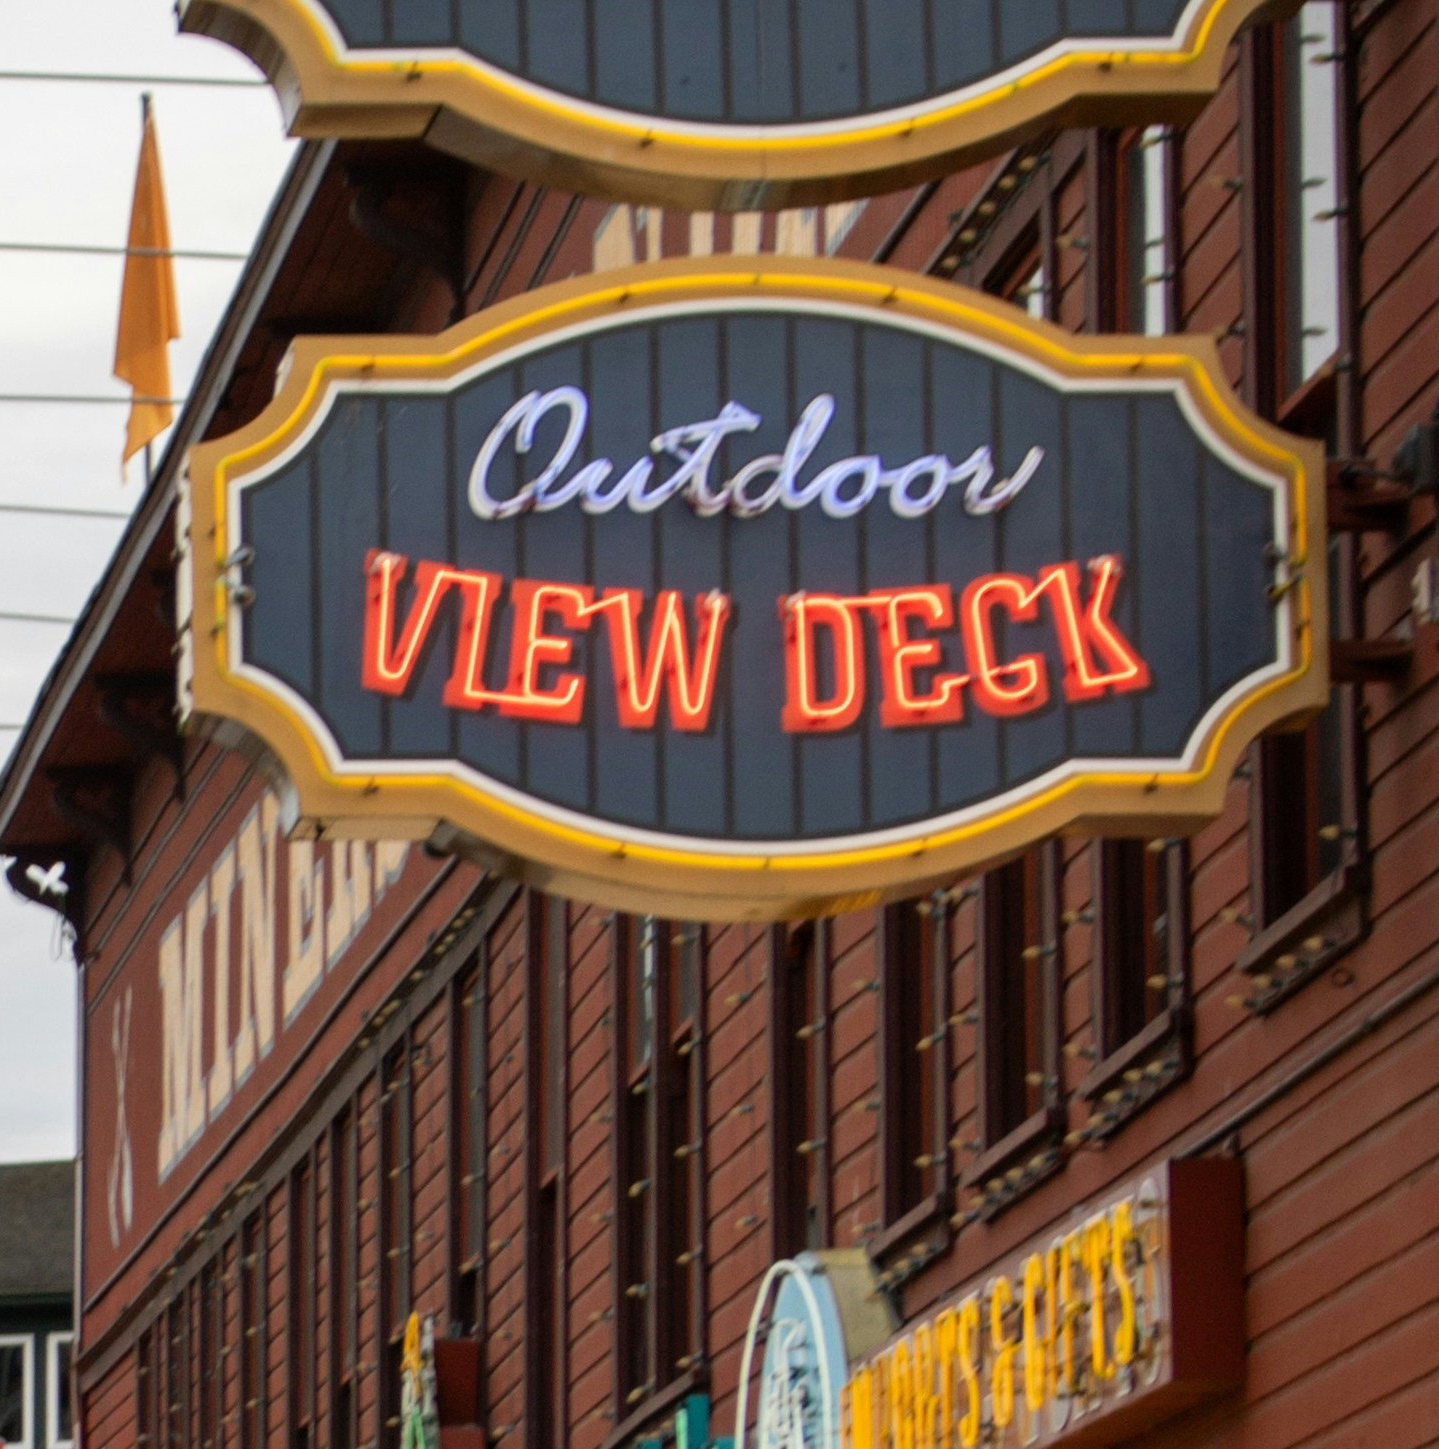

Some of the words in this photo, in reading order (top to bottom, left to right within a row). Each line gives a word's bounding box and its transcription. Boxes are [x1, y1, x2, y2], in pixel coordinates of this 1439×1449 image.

[467, 386, 1045, 521] Outdoor
[360, 550, 731, 733] VIEW
[780, 554, 1149, 733] DECK
